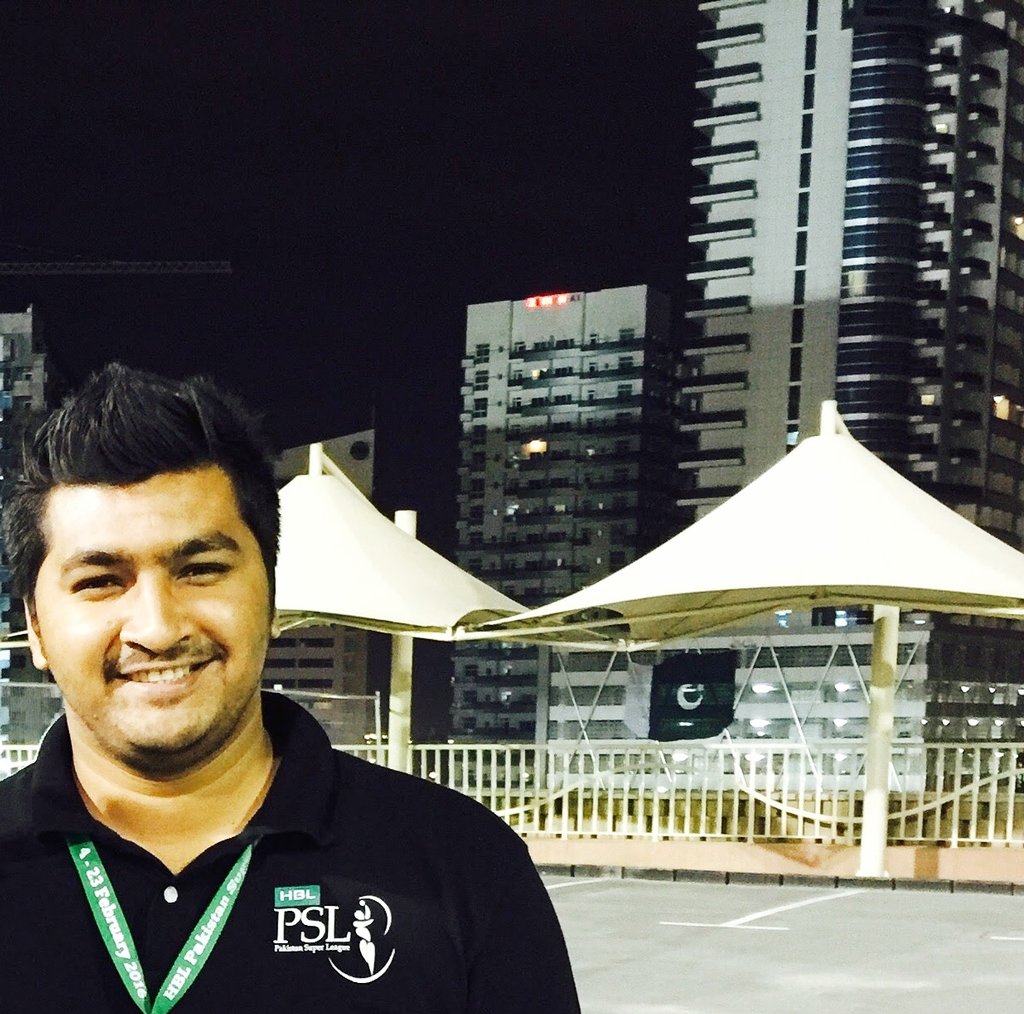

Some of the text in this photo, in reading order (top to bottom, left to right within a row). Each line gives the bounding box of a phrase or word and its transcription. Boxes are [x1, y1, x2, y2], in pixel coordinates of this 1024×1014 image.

[85, 866, 104, 888] 23
[279, 888, 316, 902] HBL
[94, 886, 131, 959] February
[273, 905, 351, 944] PSL
[162, 966, 192, 1001] HBL
[183, 895, 230, 966] Pakistan
[274, 943, 351, 954] Pakistan Super League
[123, 961, 147, 999] 2016
